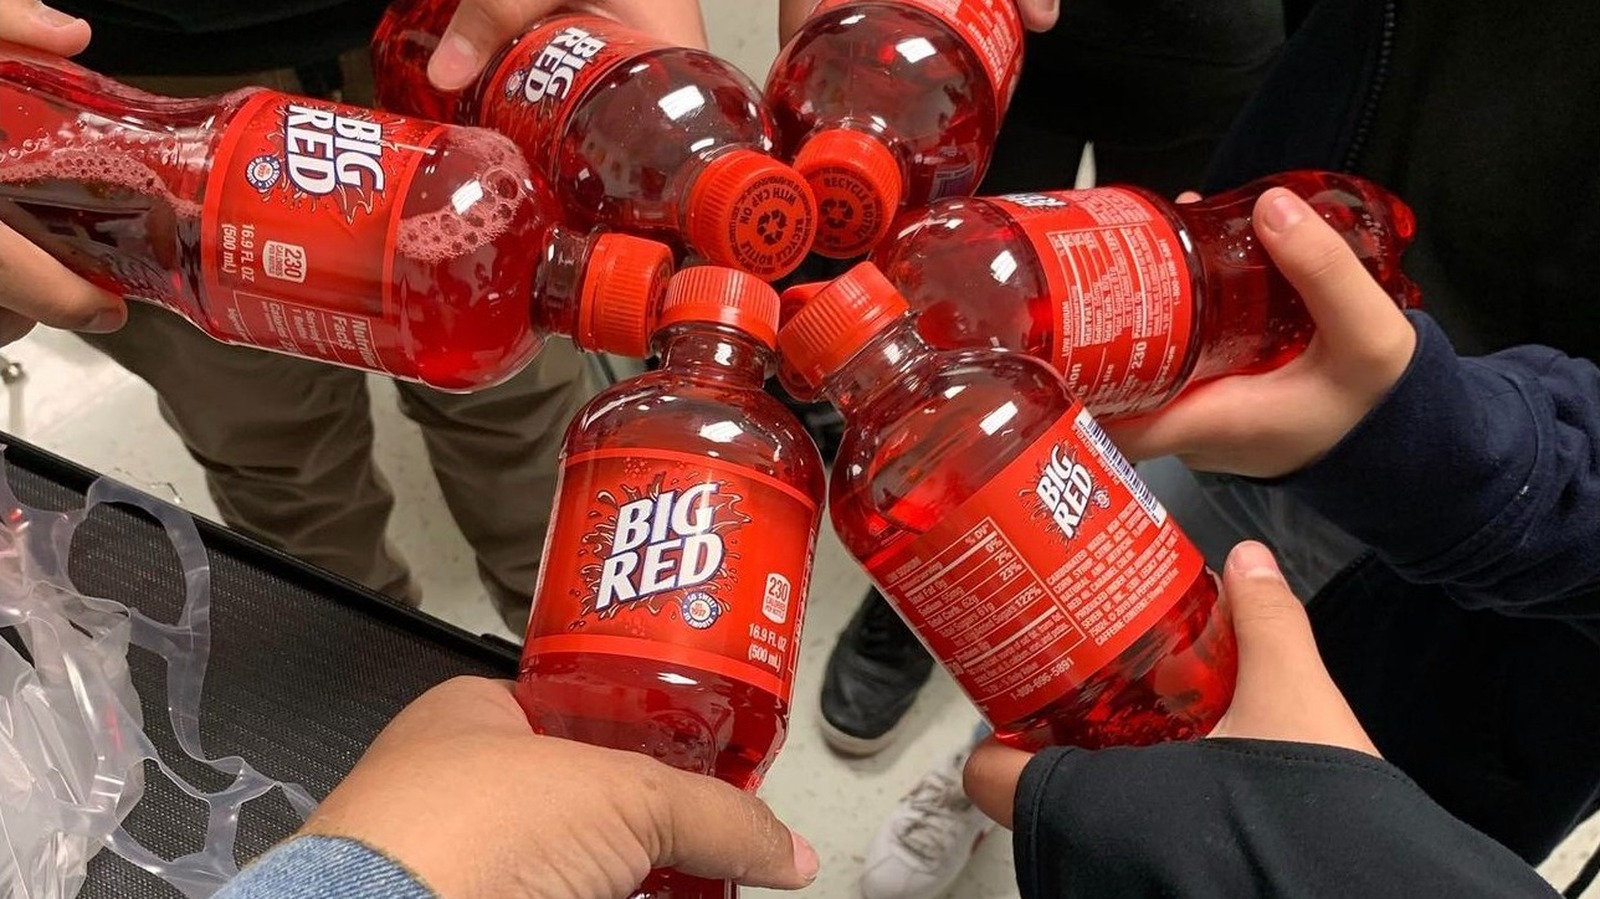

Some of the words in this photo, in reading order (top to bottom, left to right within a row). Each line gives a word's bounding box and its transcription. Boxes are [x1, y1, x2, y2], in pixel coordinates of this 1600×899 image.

[523, 26, 590, 103] RED
[549, 35, 608, 100] BIG
[286, 103, 337, 196] RED
[334, 115, 386, 193] BIG
[751, 188, 771, 206] CAP
[772, 187, 798, 206] WITH
[822, 176, 868, 203] RECYCLE
[739, 207, 753, 225] ON
[221, 223, 237, 248] (500
[242, 223, 255, 249] 16.9
[776, 219, 806, 263] RECYCLE
[220, 249, 236, 275] mL)
[241, 250, 254, 265] FL
[284, 247, 302, 282] 230
[740, 239, 776, 266] BOTTLE
[241, 267, 255, 283] OZ
[332, 315, 349, 351] Facts
[1131, 341, 1148, 369] 230
[1035, 444, 1074, 513] BIG
[1053, 462, 1094, 539] RED
[611, 482, 720, 556] BIG
[984, 536, 1004, 555] 0%
[994, 548, 1014, 566] 2%
[595, 532, 725, 612] RED
[960, 592, 979, 610] 62g
[998, 560, 1024, 582] 23%
[768, 577, 789, 602] 230
[1014, 584, 1043, 608] 122%
[976, 600, 996, 619] 61g
[748, 622, 768, 642] 16.9
[777, 635, 787, 653] OZ
[748, 643, 768, 663] (500
[768, 653, 782, 673] mL)
